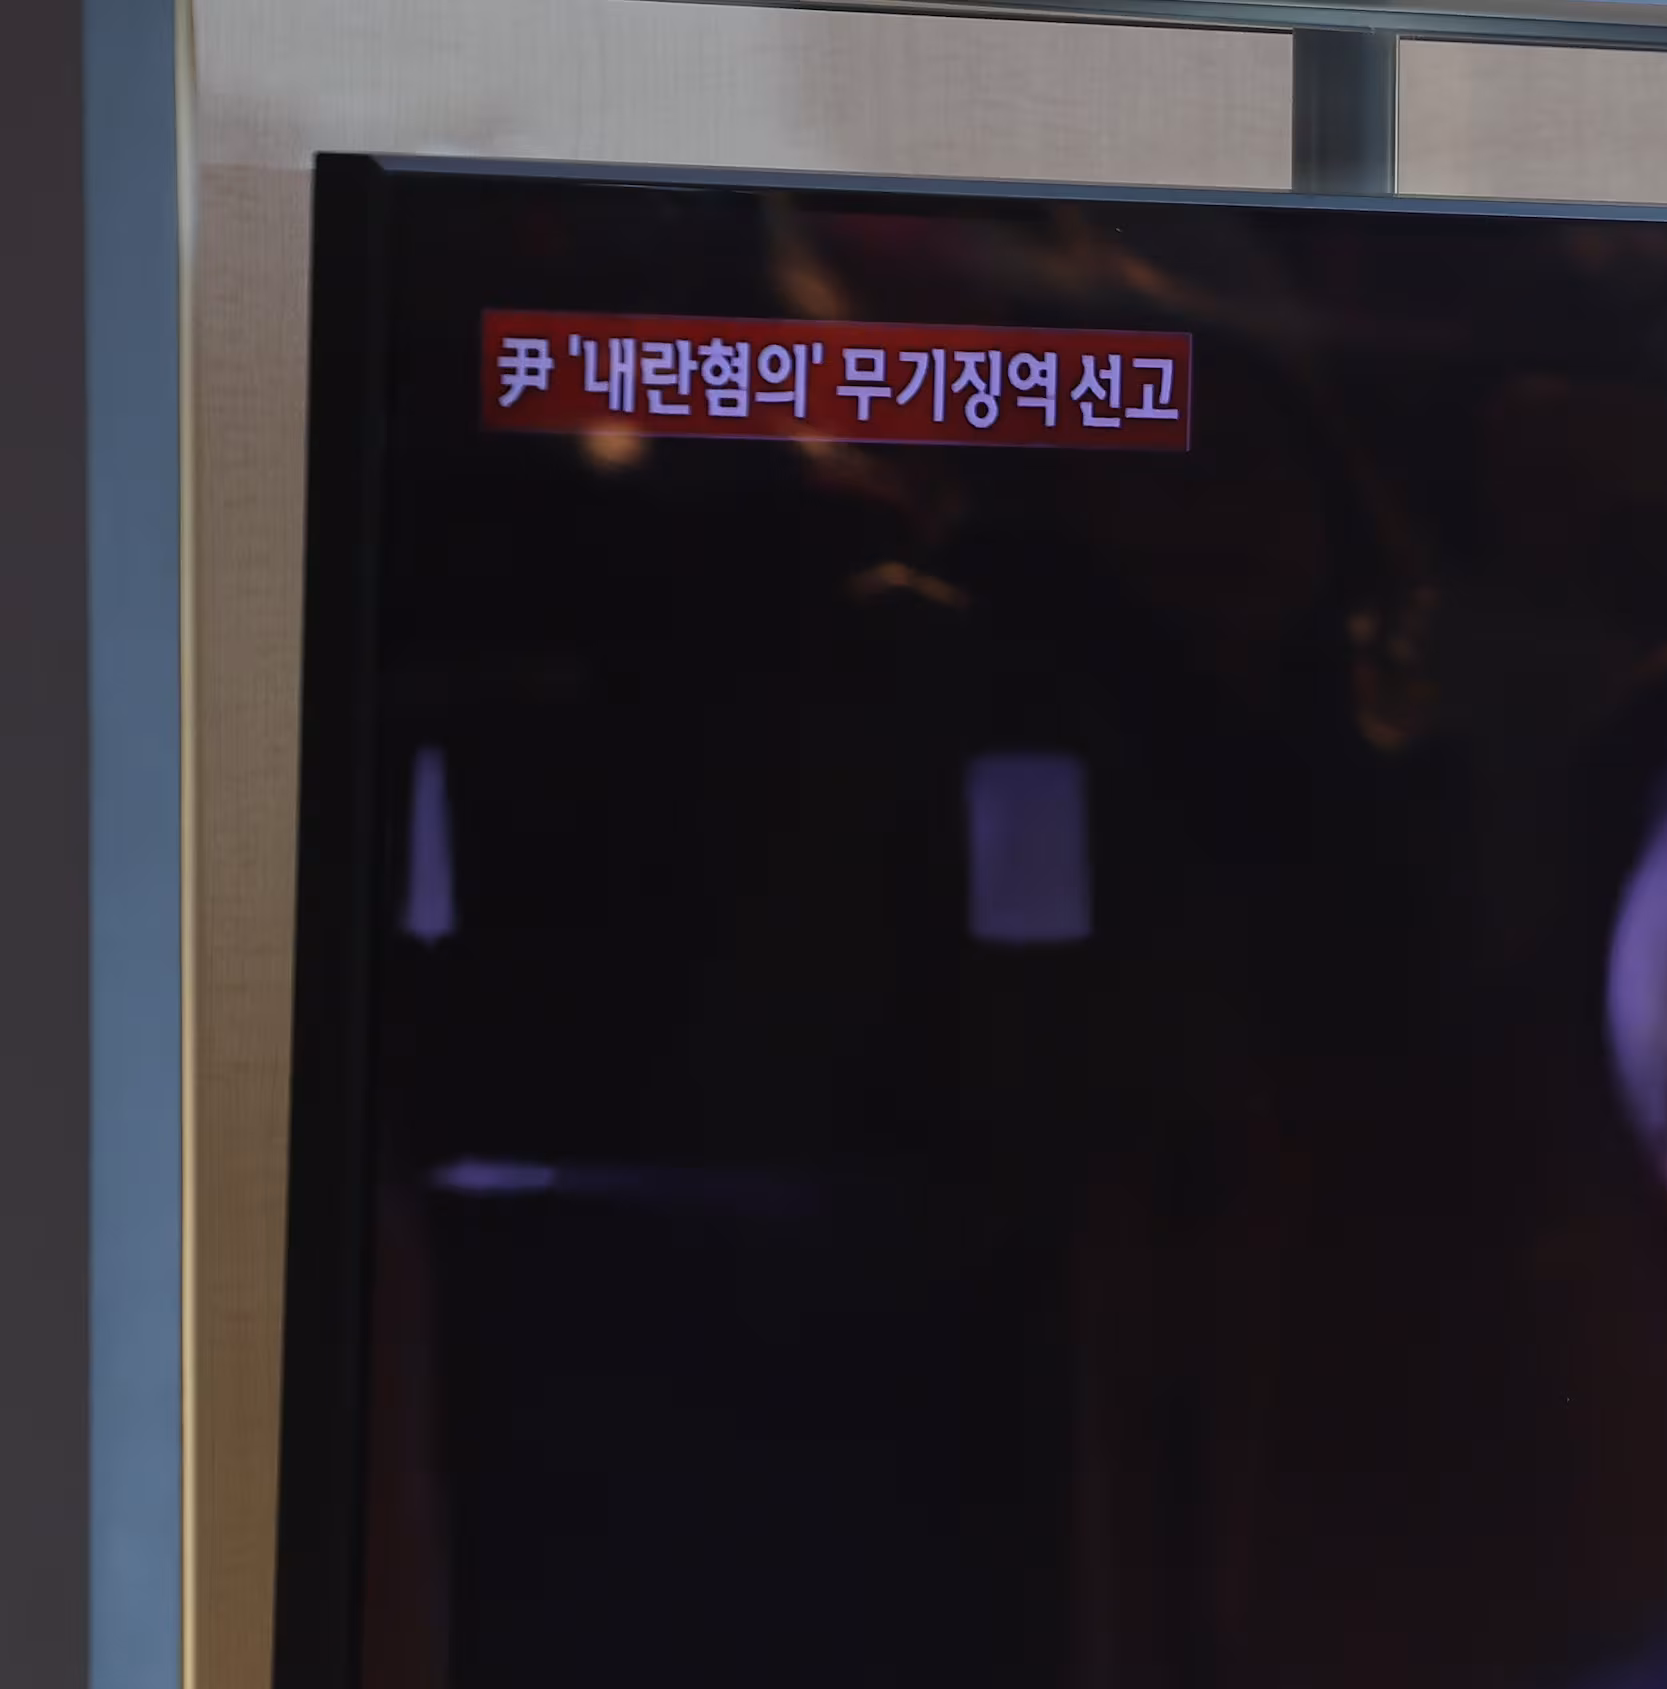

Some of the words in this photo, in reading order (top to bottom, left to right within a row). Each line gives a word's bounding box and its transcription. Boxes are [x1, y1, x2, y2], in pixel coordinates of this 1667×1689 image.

[497, 336, 554, 408] 尹
[567, 333, 824, 420] '내란혐의'
[836, 348, 1057, 428] 무기징역
[1070, 353, 1179, 428] 선고
